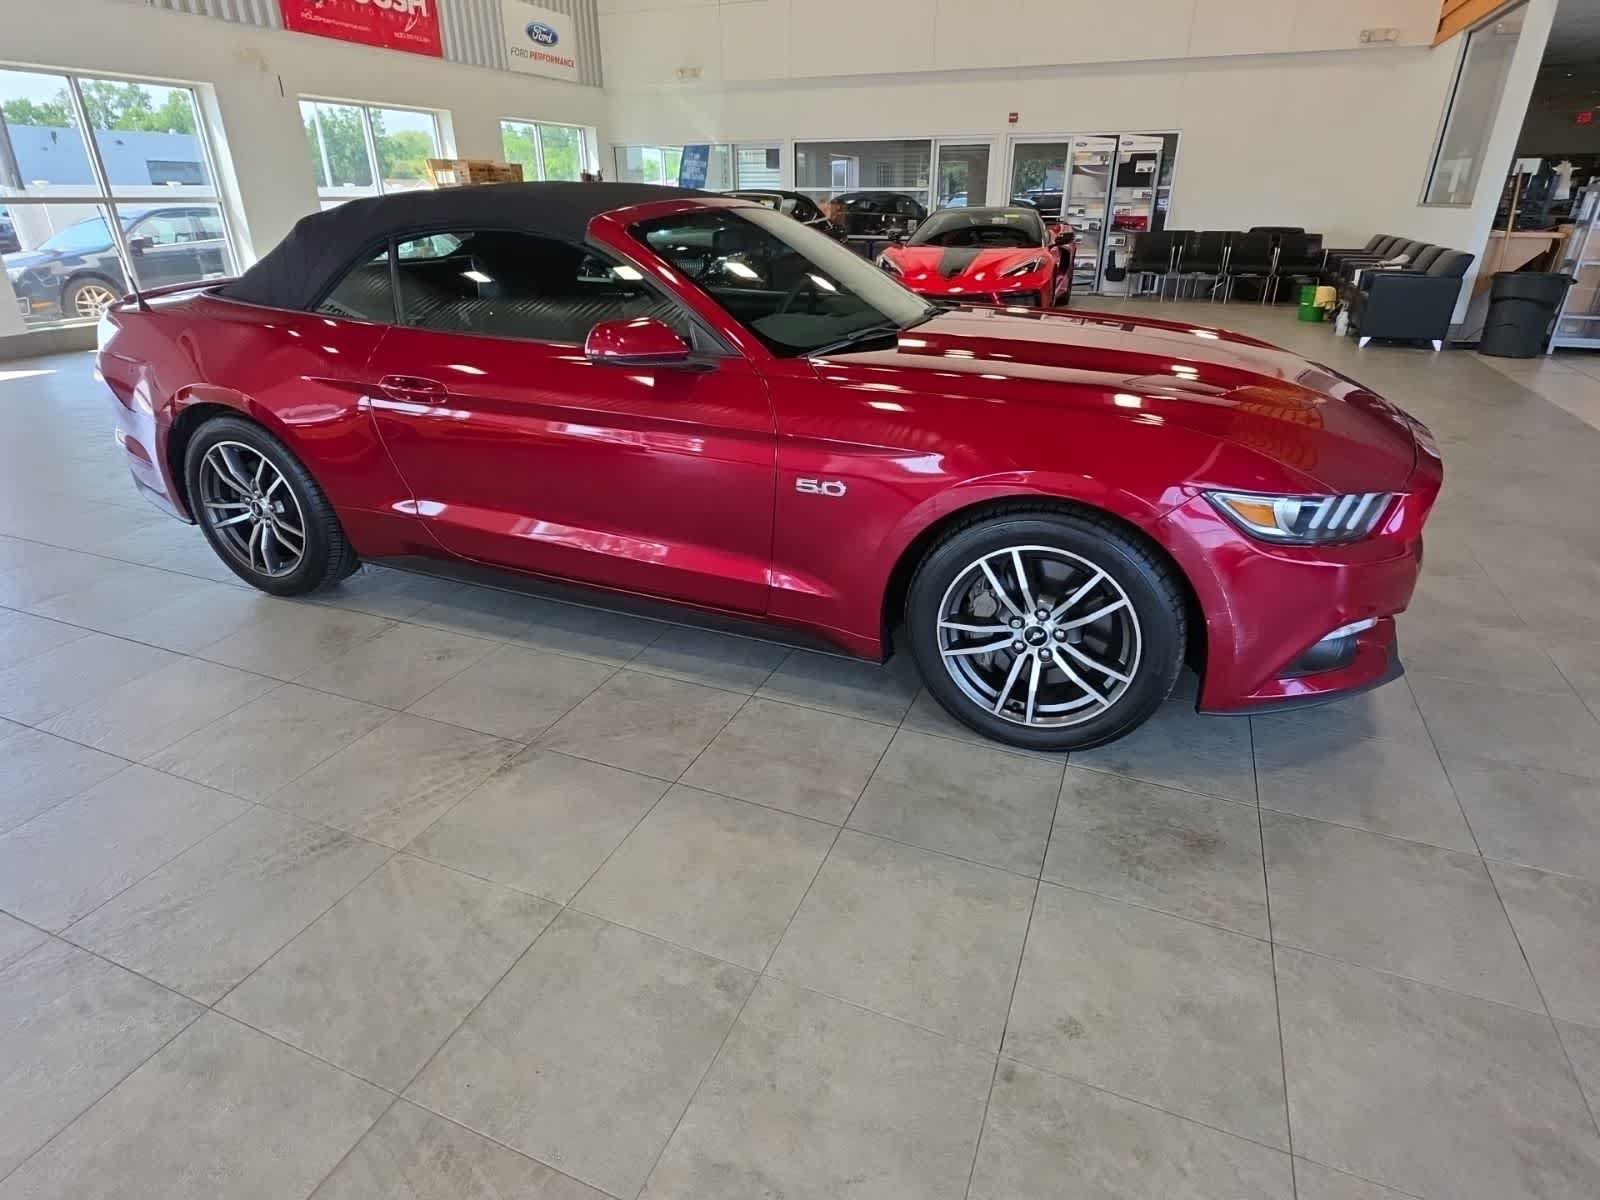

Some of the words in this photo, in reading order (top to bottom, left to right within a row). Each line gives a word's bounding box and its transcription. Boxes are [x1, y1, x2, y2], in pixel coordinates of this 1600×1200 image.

[532, 25, 553, 44] Ford
[510, 47, 529, 58] FORD
[529, 50, 575, 68] PERFORMANCE
[795, 477, 847, 497] 5.0
